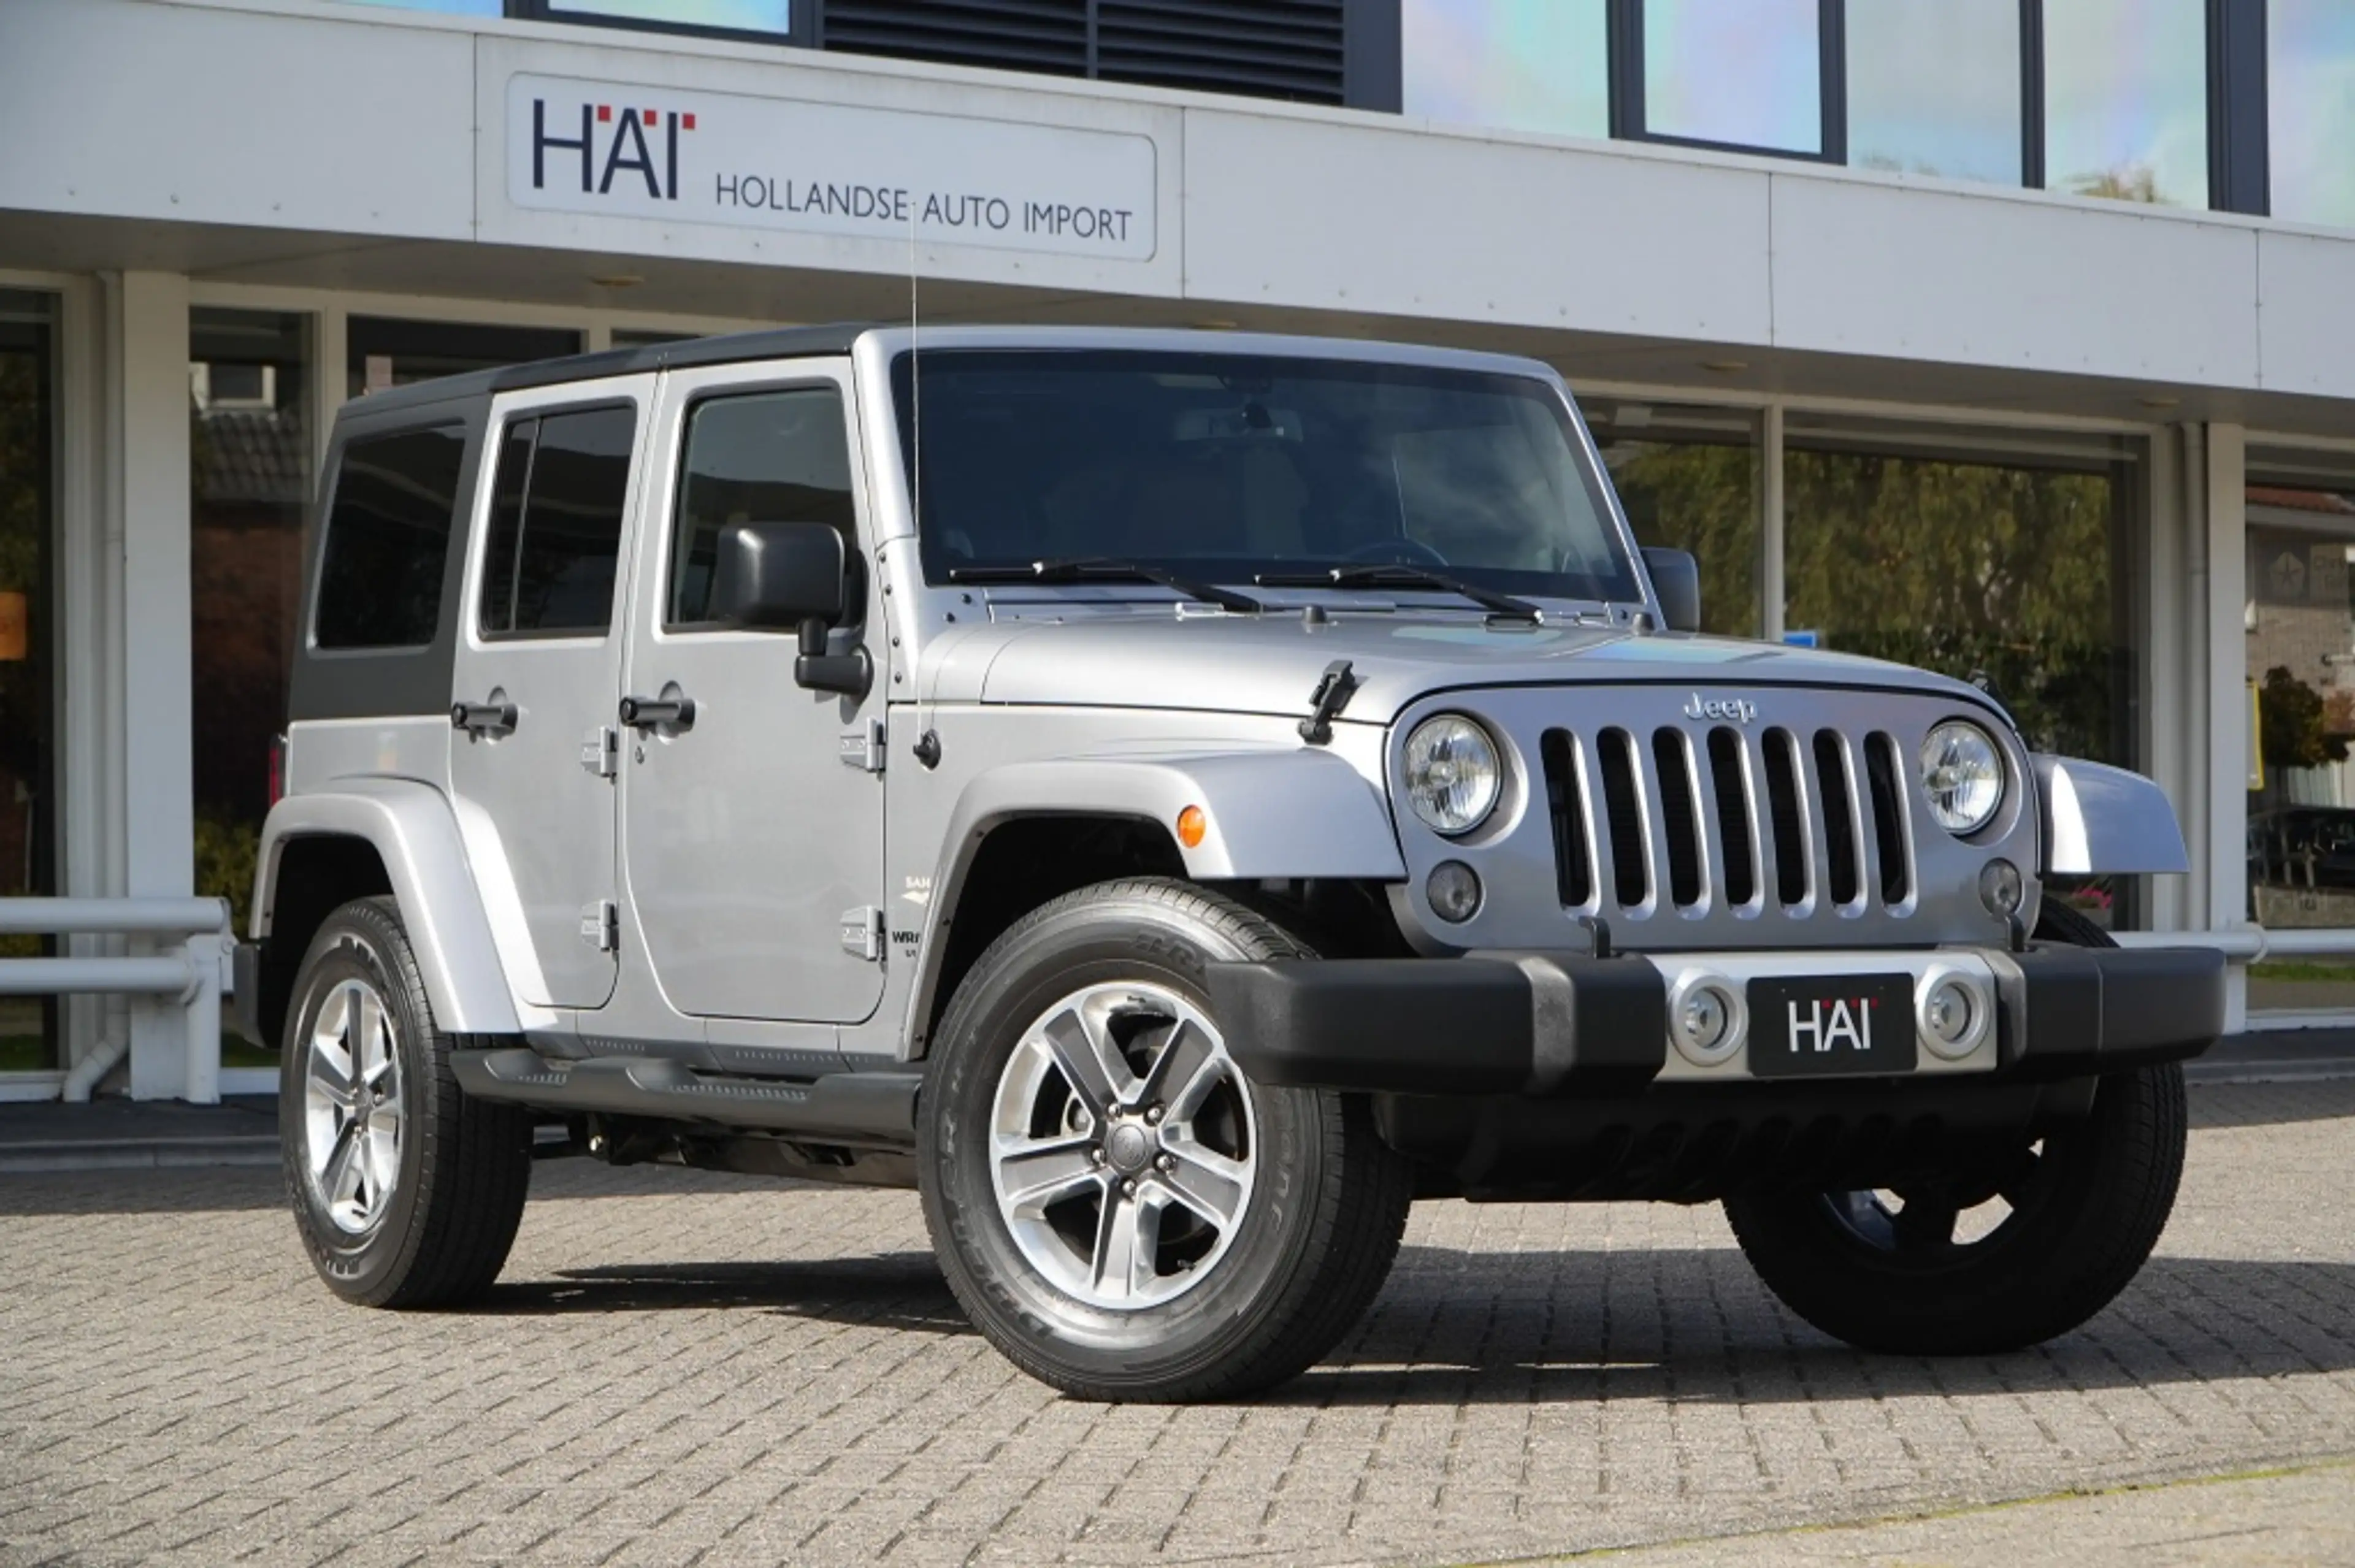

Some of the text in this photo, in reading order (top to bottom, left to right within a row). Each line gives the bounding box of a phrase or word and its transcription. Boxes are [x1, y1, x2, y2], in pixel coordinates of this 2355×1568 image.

[716, 172, 1133, 241] HOLLANDSE AUTO IMPORT
[1683, 692, 1758, 724] Jeep
